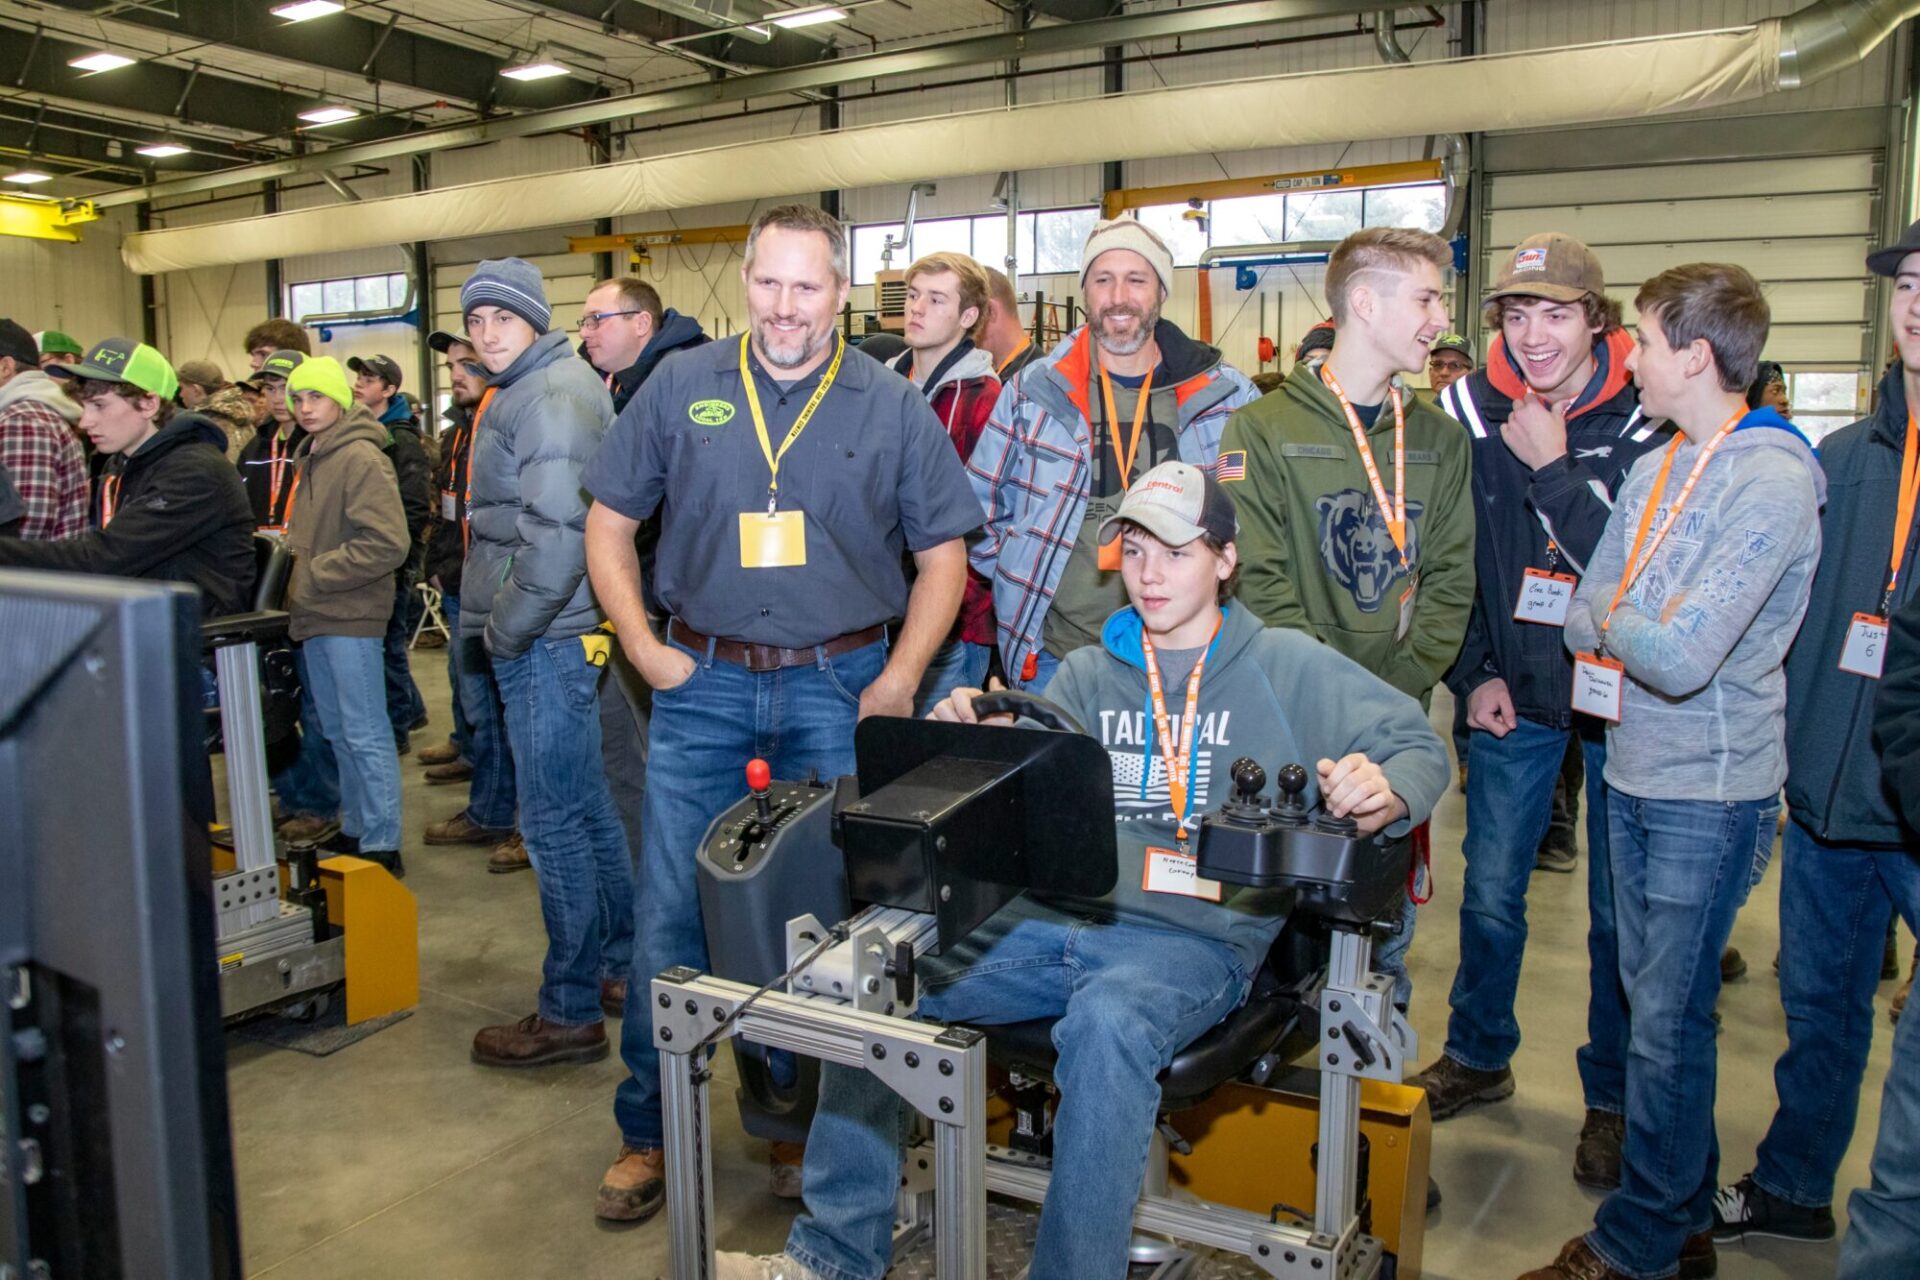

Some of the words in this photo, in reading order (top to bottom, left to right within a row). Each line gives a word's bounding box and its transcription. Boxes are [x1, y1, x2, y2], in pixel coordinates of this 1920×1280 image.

[1297, 446, 1331, 456] CHICAGO
[1407, 452, 1432, 461] BEARS
[1865, 643, 1877, 657] 6
